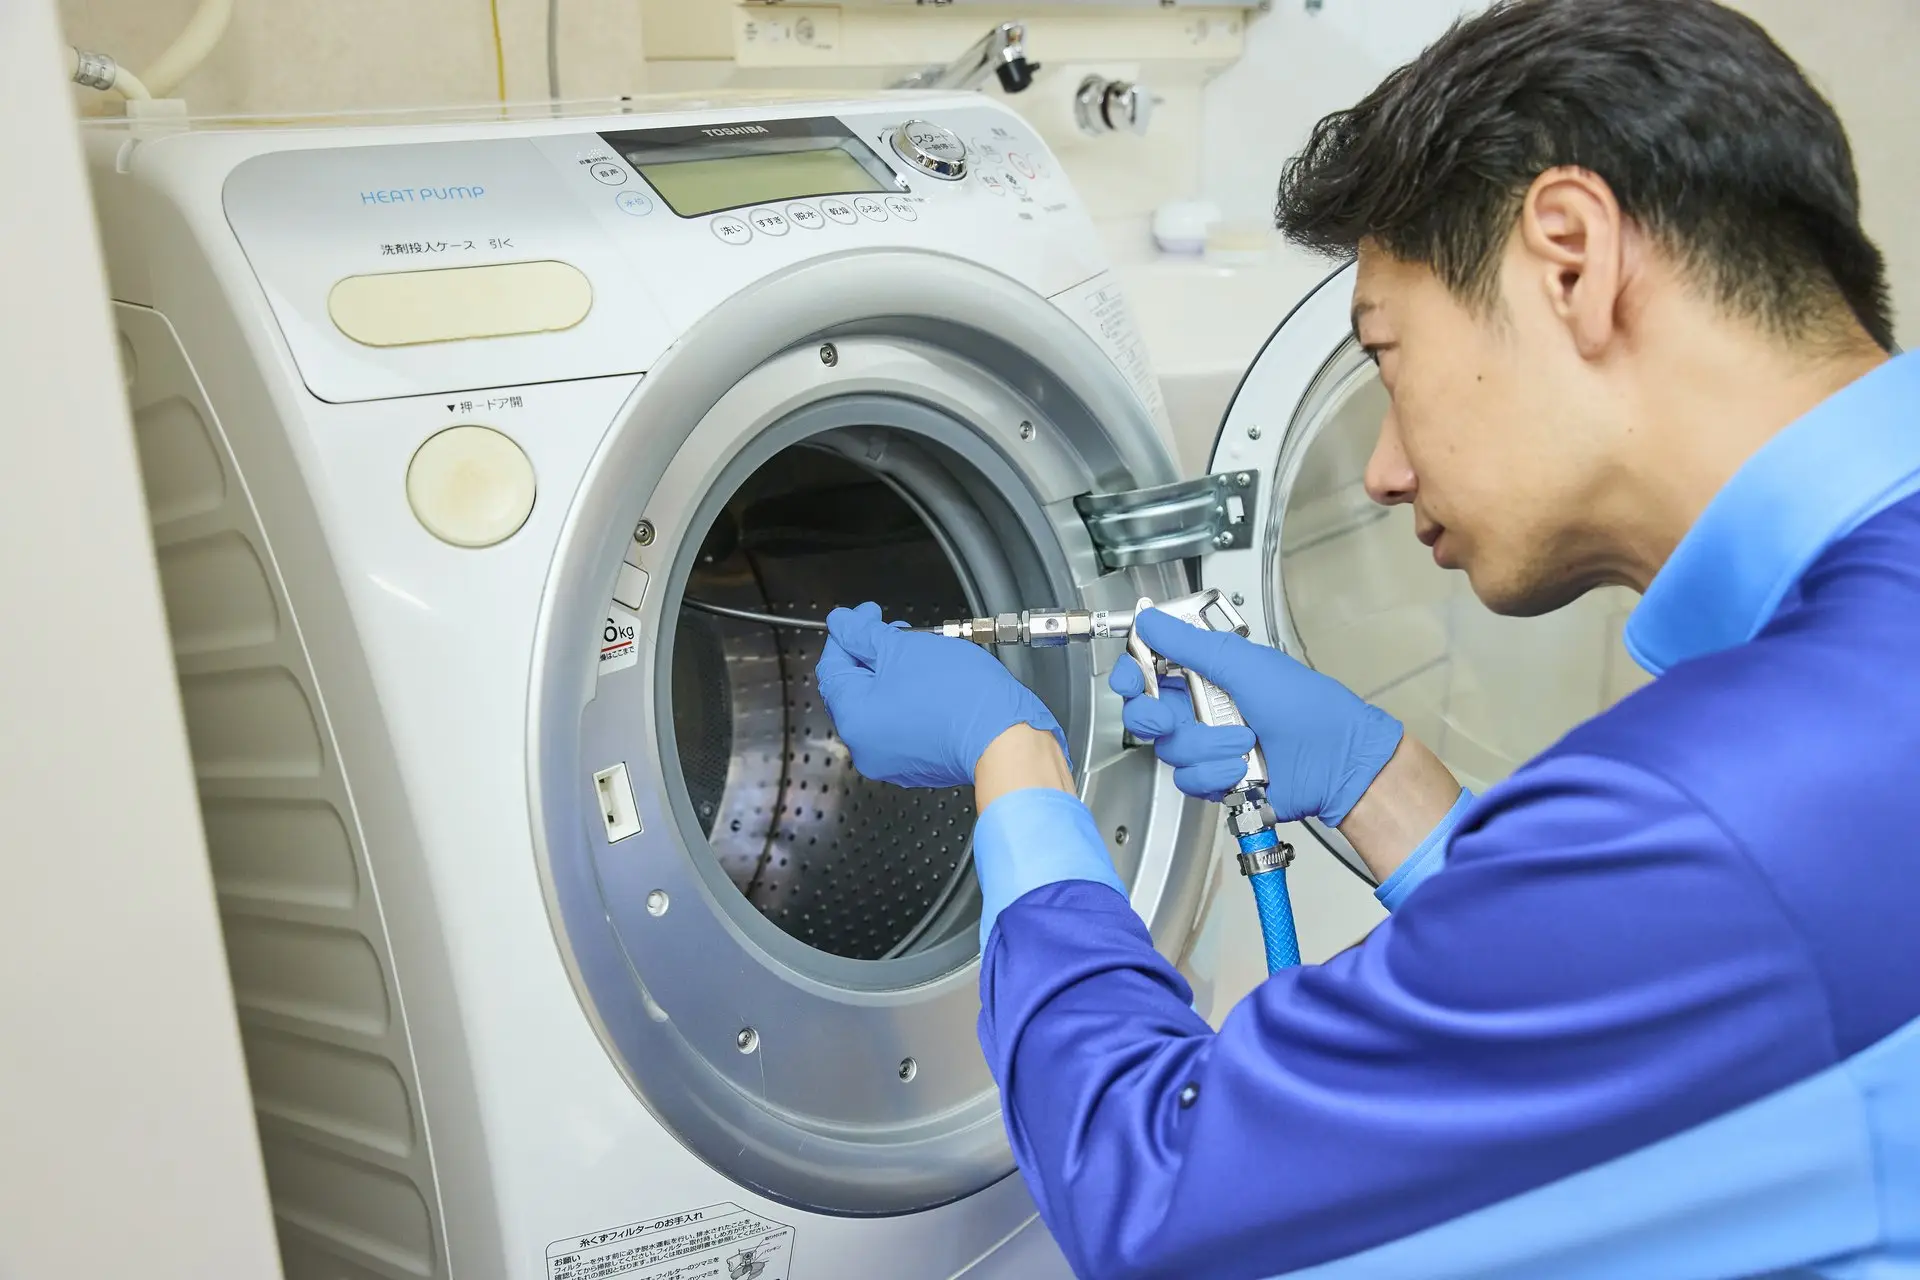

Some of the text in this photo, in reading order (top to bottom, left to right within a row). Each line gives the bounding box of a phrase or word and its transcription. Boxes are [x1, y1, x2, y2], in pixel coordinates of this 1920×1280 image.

[702, 125, 769, 137] TOSHIBA
[912, 133, 949, 145] スタート
[600, 169, 619, 178] 音声
[360, 185, 485, 206] HEAT PUMP
[794, 210, 817, 221] 脱水
[829, 206, 850, 217] 乾燥
[756, 216, 783, 228] すすぎ
[720, 224, 744, 237] 洗い
[380, 238, 515, 256] 洗剤投入ケース 引く
[579, 1211, 704, 1249] 糸くずフィルターのお手入れ
[554, 1254, 581, 1267] お願い
